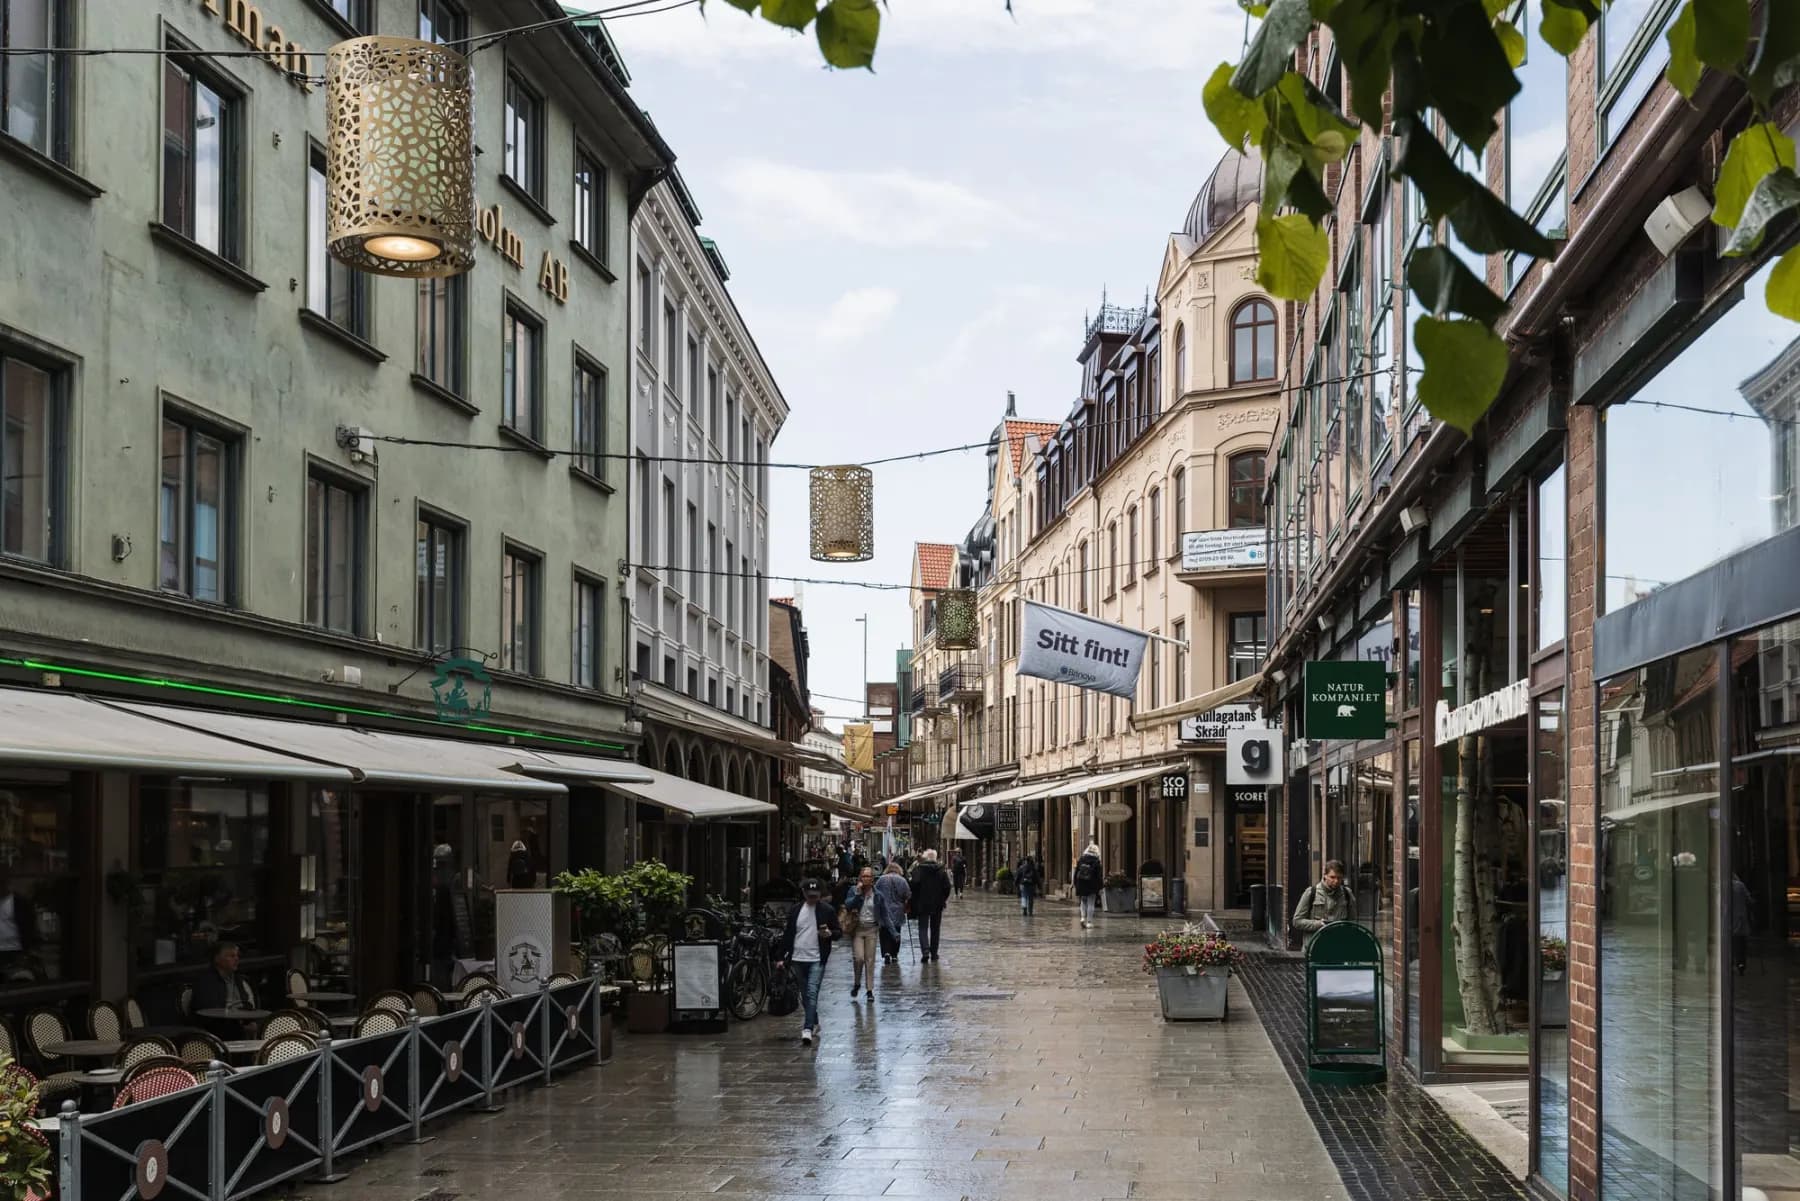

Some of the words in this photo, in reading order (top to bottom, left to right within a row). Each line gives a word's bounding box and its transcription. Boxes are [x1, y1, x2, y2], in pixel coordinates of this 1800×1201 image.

[541, 250, 569, 304] AB
[1036, 628, 1080, 656] Sitt
[1083, 639, 1130, 668] fint!
[1327, 683, 1366, 692] NATUR
[1312, 693, 1380, 702] KOMPANIET
[1195, 709, 1257, 724] Kullagatans
[1241, 739, 1271, 779] g
[1162, 776, 1185, 786] SCO
[1162, 787, 1185, 797] RETT
